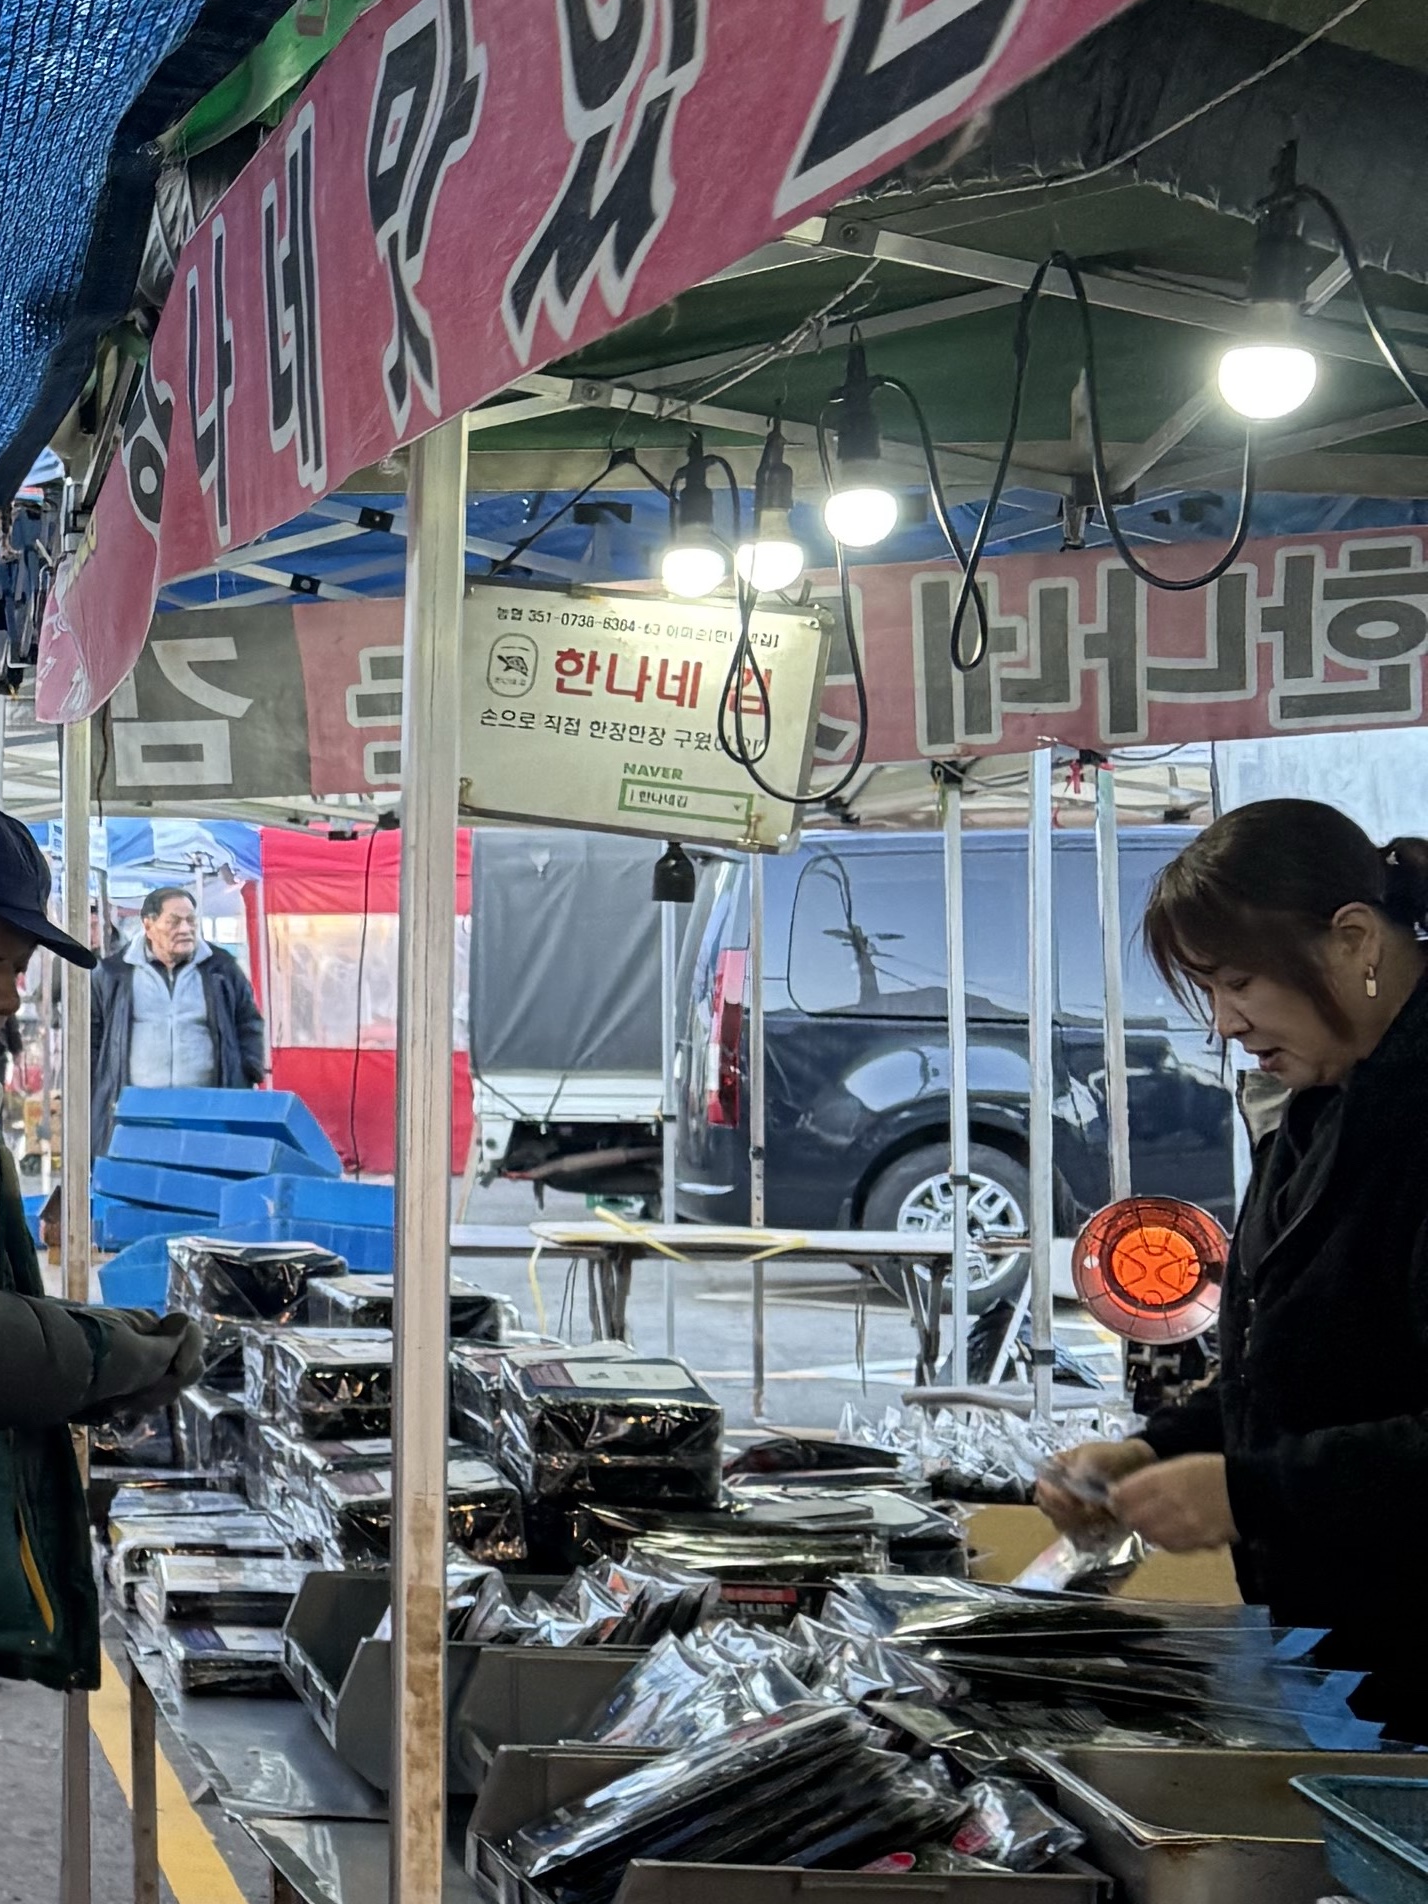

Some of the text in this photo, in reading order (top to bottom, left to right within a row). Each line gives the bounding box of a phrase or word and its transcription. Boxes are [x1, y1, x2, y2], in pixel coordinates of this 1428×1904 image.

[554, 647, 773, 716] 한나네 김
[479, 707, 537, 731] 손으로
[543, 713, 582, 737] 직접
[588, 720, 667, 748] 한장한장
[623, 761, 684, 781] NAVER
[638, 790, 690, 809] 한나네김
